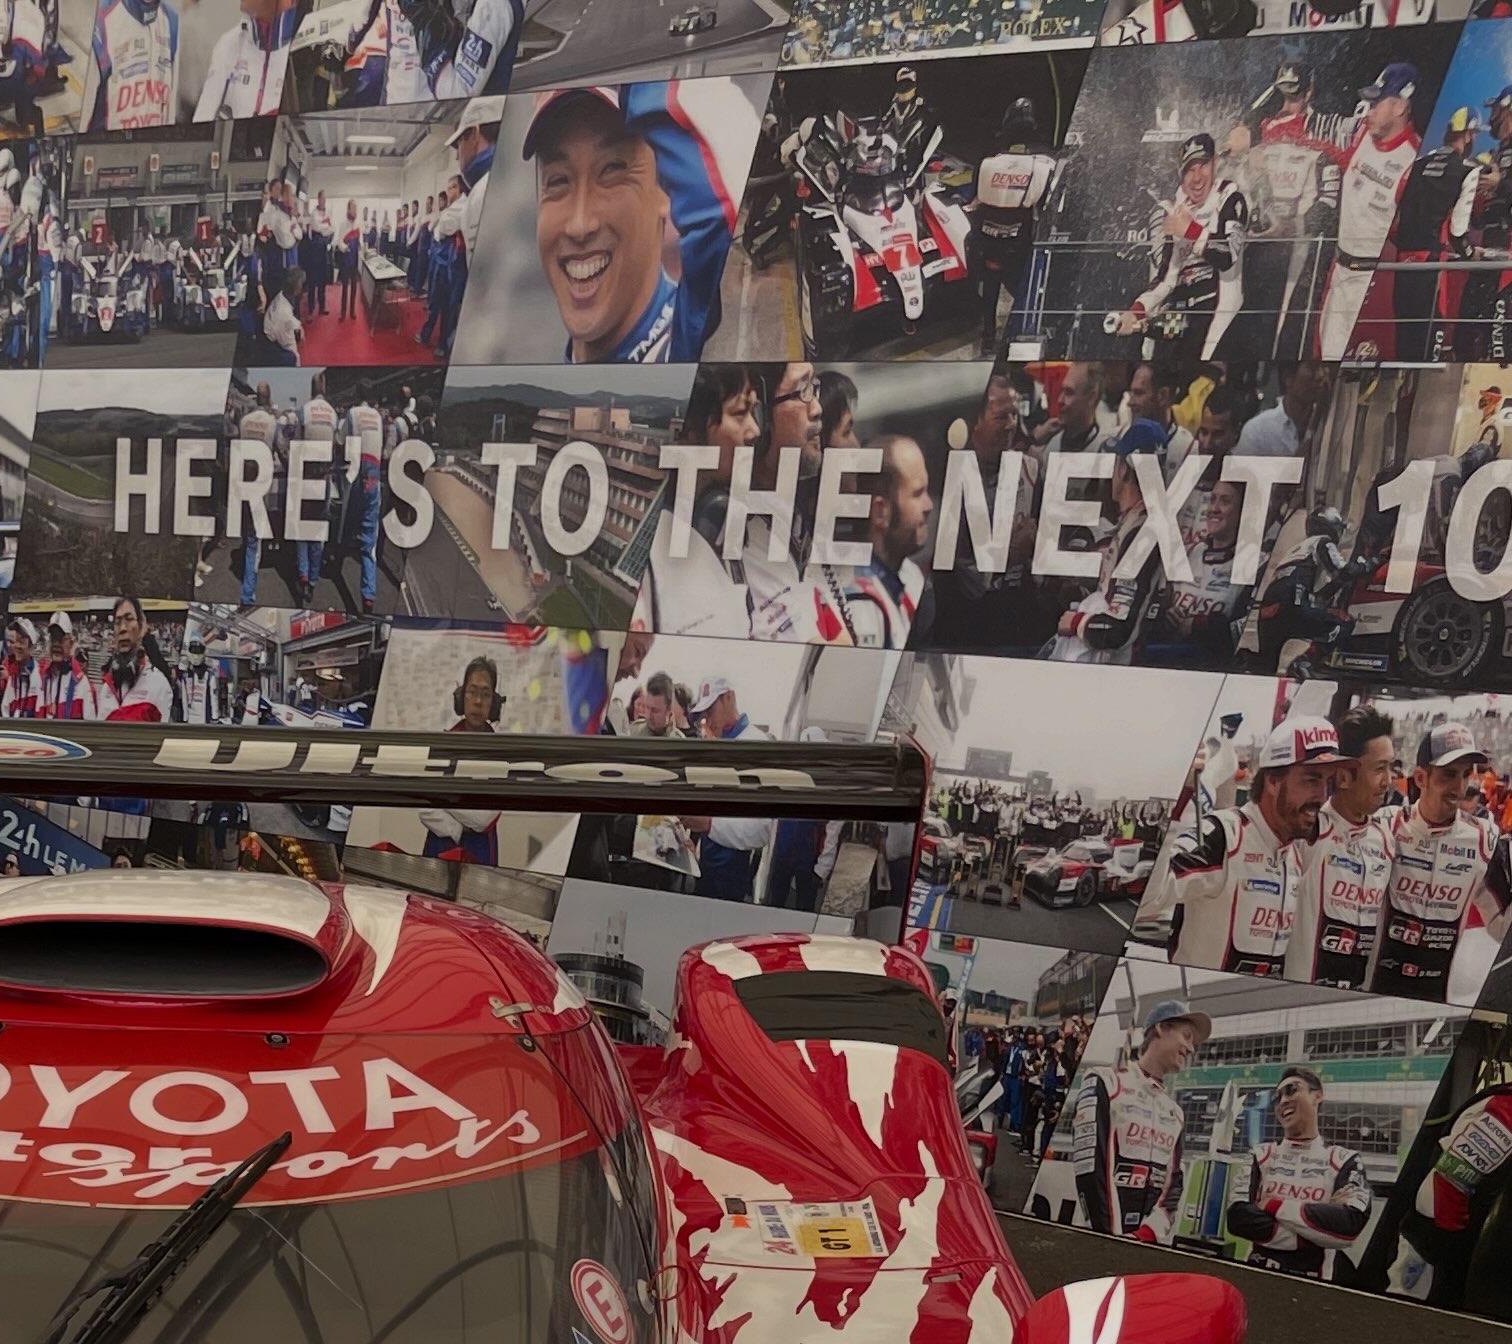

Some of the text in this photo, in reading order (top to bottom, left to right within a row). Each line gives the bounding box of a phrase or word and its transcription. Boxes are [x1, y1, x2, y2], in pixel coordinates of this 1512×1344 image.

[1000, 16, 1069, 38] ROLEX
[116, 79, 171, 113] DENSO
[991, 172, 1032, 188] DENSO
[892, 244, 908, 271] 7
[1492, 299, 1506, 359] DENSO
[114, 436, 437, 549] HERE'S
[481, 440, 610, 557] TO
[659, 444, 884, 567] THE
[932, 448, 1305, 587] NEXT
[153, 738, 816, 789] Ultron
[43, 844, 68, 867] LE
[1439, 843, 1467, 857] Mobil
[1395, 876, 1463, 902] DENSO
[1321, 935, 1355, 956] GR
[1388, 924, 1421, 947] GR
[1125, 1122, 1175, 1148] DENSO
[1114, 1171, 1147, 1188] GR
[1265, 1181, 1327, 1201] DENSO
[820, 1236, 852, 1250] GT
[586, 1279, 624, 1335] E
